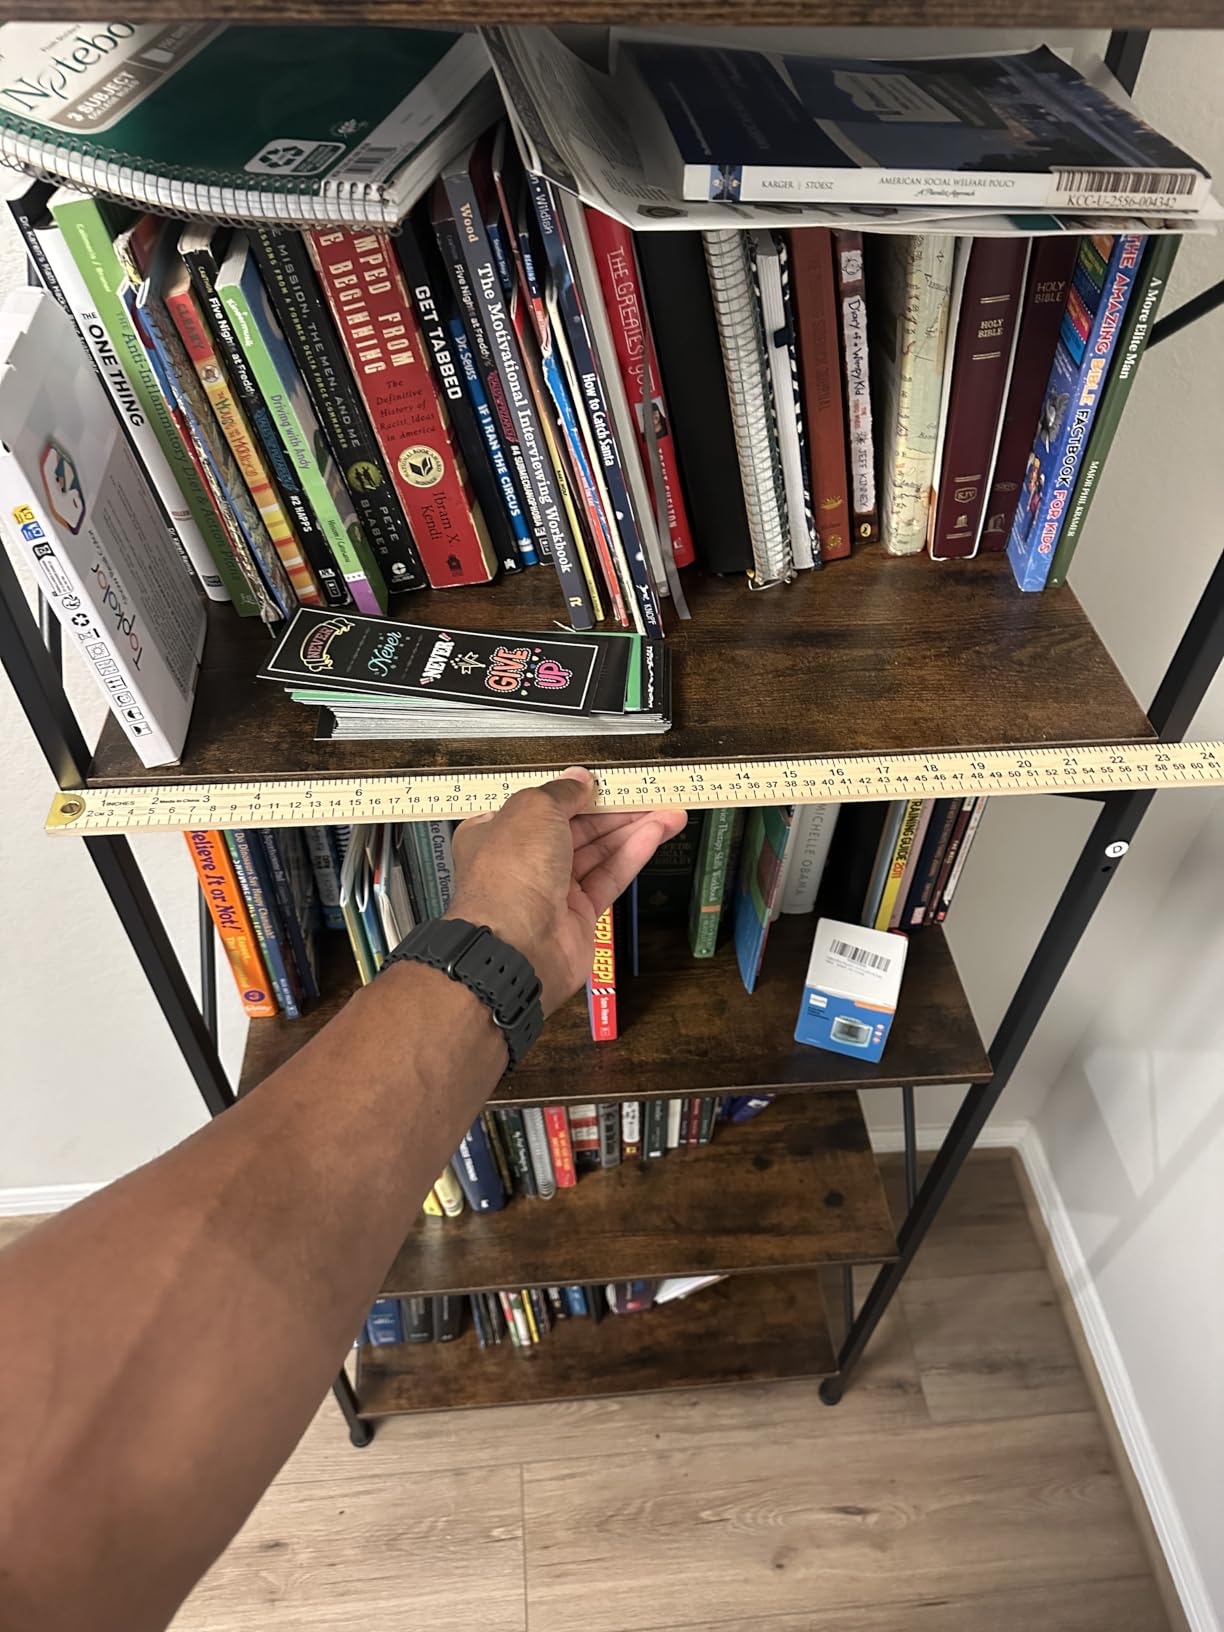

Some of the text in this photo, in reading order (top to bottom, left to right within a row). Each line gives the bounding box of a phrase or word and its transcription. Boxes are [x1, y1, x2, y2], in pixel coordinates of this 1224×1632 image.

[66, 71, 136, 122] 3 SUBJECT
[761, 179, 835, 191] KARGER STOESZ
[878, 176, 1016, 188] AMERICAN SOCIAL WELFARE POLICY
[536, 193, 553, 235] Wildish
[1066, 194, 1178, 209] KCC-U-2556-004342
[460, 202, 480, 243] Wood
[19, 215, 58, 288] Dr. Karen's Math
[524, 253, 536, 282] READING
[611, 246, 629, 280] THE
[1119, 233, 1143, 270] THE
[454, 263, 466, 285] Five
[469, 317, 480, 331] at
[1034, 291, 1064, 304] BIBLE
[1037, 281, 1066, 292] HOLY
[81, 312, 97, 320] THE
[209, 297, 245, 367] Five at
[328, 260, 387, 375] BEGINNING
[847, 299, 861, 332] Diary
[980, 318, 1005, 329] HOLY
[1094, 272, 1131, 355] AMAZING
[1118, 276, 1163, 380] A More Elite Man
[277, 243, 362, 449] MISSION, THE MEN, AND ME
[378, 311, 416, 368] FROM
[415, 285, 463, 400] GET TABBED
[977, 327, 1004, 338] BIBLE
[88, 322, 144, 428] ONE THING
[273, 268, 349, 450] FROM FORMER DELTA FORCE COMMANDER
[454, 334, 478, 382] Dr. Seuss
[850, 347, 865, 380] Wimpy
[122, 330, 188, 463] Anti-Inflammatory
[376, 390, 422, 405] Definitive
[386, 380, 403, 389] The
[854, 380, 865, 397] Kid
[1078, 357, 1106, 407] BIBLE
[380, 413, 435, 431] Racist Ideas
[478, 402, 491, 417] IF
[478, 262, 495, 300] The
[487, 302, 529, 411] Motivational
[516, 406, 553, 504] Interviewing
[545, 505, 574, 574] Workbook
[581, 372, 616, 468] How to Catch Santa
[270, 394, 312, 472] Driving with Andy
[400, 427, 436, 440] America
[483, 423, 502, 451] RAN
[1054, 409, 1091, 488] FACTBOOK
[492, 452, 508, 475] THE
[855, 446, 870, 508] JEFF KINNEY
[1085, 461, 1101, 488] MAJOR
[500, 475, 521, 518] CIRCUS
[510, 444, 543, 530] #4 SUBMECHANOPHOBIA
[1046, 490, 1068, 521] FOR
[289, 494, 313, 534] #2 HAPPS
[360, 498, 389, 557] BLABER
[379, 504, 400, 543] PETE
[420, 504, 443, 541] Kendi
[432, 491, 461, 544] Ibram X
[1066, 506, 1085, 538] KRAMER
[1037, 522, 1059, 554] KIDS
[91, 563, 144, 672] Topkolor
[643, 603, 657, 627] KNOPF
[306, 626, 336, 660] NEVER
[367, 630, 402, 678] Never
[422, 640, 456, 680] NEVER
[486, 647, 531, 692] GIVE
[536, 660, 572, 688] UP
[152, 797, 159, 805] 2
[642, 777, 656, 785] 12
[689, 774, 704, 783] 13
[736, 773, 750, 781] 14
[783, 770, 797, 779] 15
[829, 768, 844, 777] 16
[876, 766, 890, 774] 17
[970, 762, 985, 770] 19
[1017, 760, 1032, 768] 20
[1064, 758, 1078, 766] 21
[1110, 756, 1125, 764] 22
[1156, 754, 1171, 762] 23
[233, 832, 245, 846] Do
[432, 833, 448, 869] Care of
[713, 823, 729, 851] Therapy
[795, 803, 827, 896] MICHELLE OBAMA
[897, 836, 912, 862] GUIDE
[209, 872, 225, 891] It
[891, 860, 907, 880] 2011
[211, 890, 226, 904] or
[215, 902, 243, 932] Not!
[593, 947, 614, 985] BEEP!
